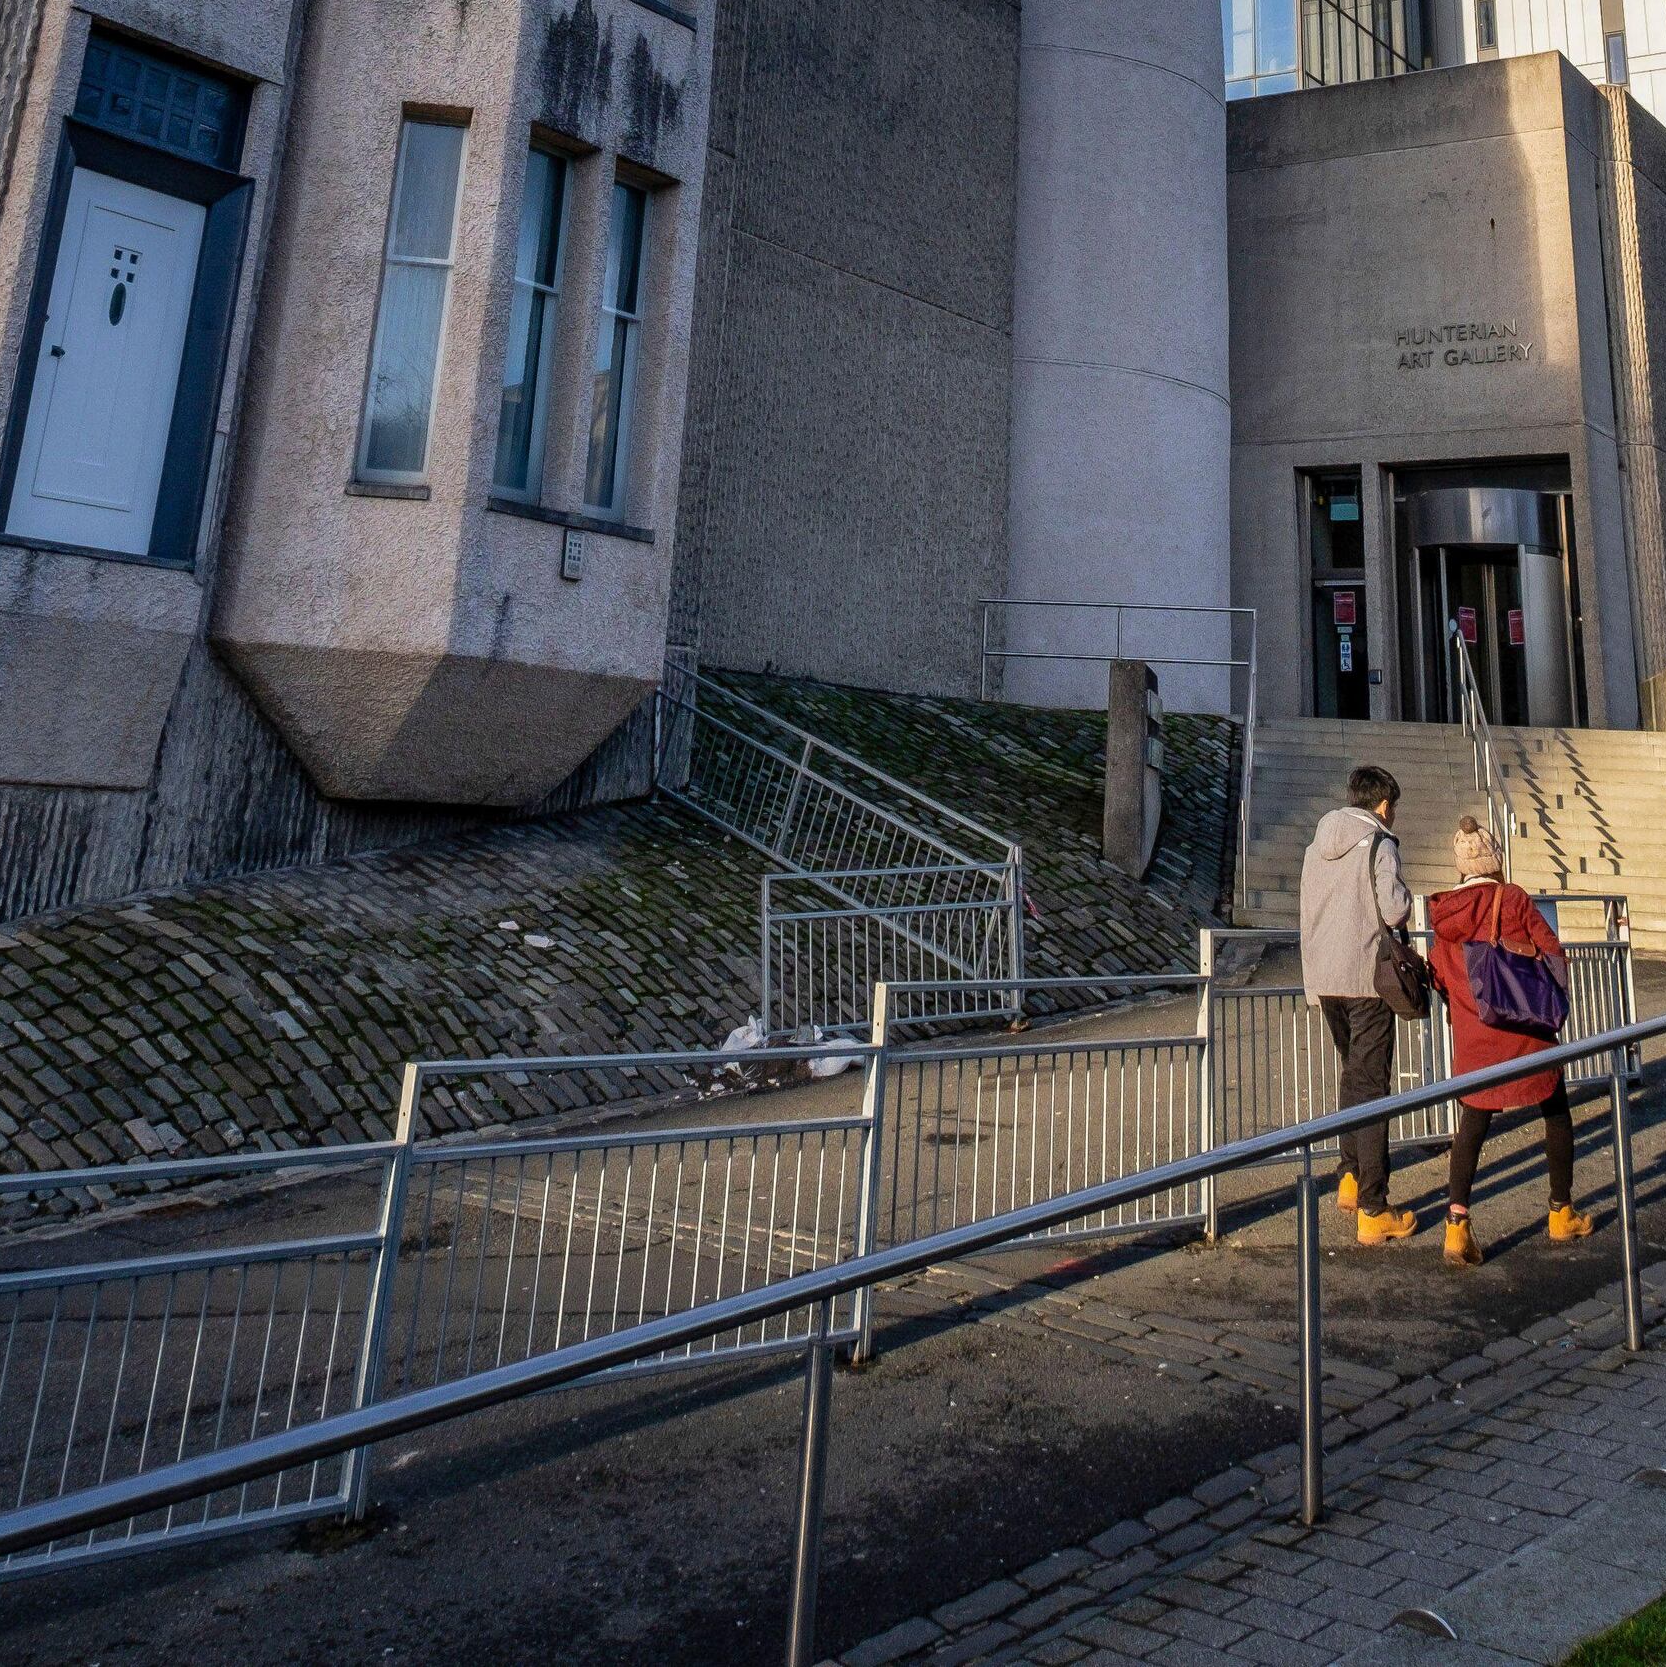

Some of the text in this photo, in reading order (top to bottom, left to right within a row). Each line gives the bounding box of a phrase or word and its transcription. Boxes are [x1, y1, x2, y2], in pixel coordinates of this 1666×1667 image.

[1395, 318, 1518, 346] HUNTERIAN
[1397, 342, 1534, 371] ART GALLERY
